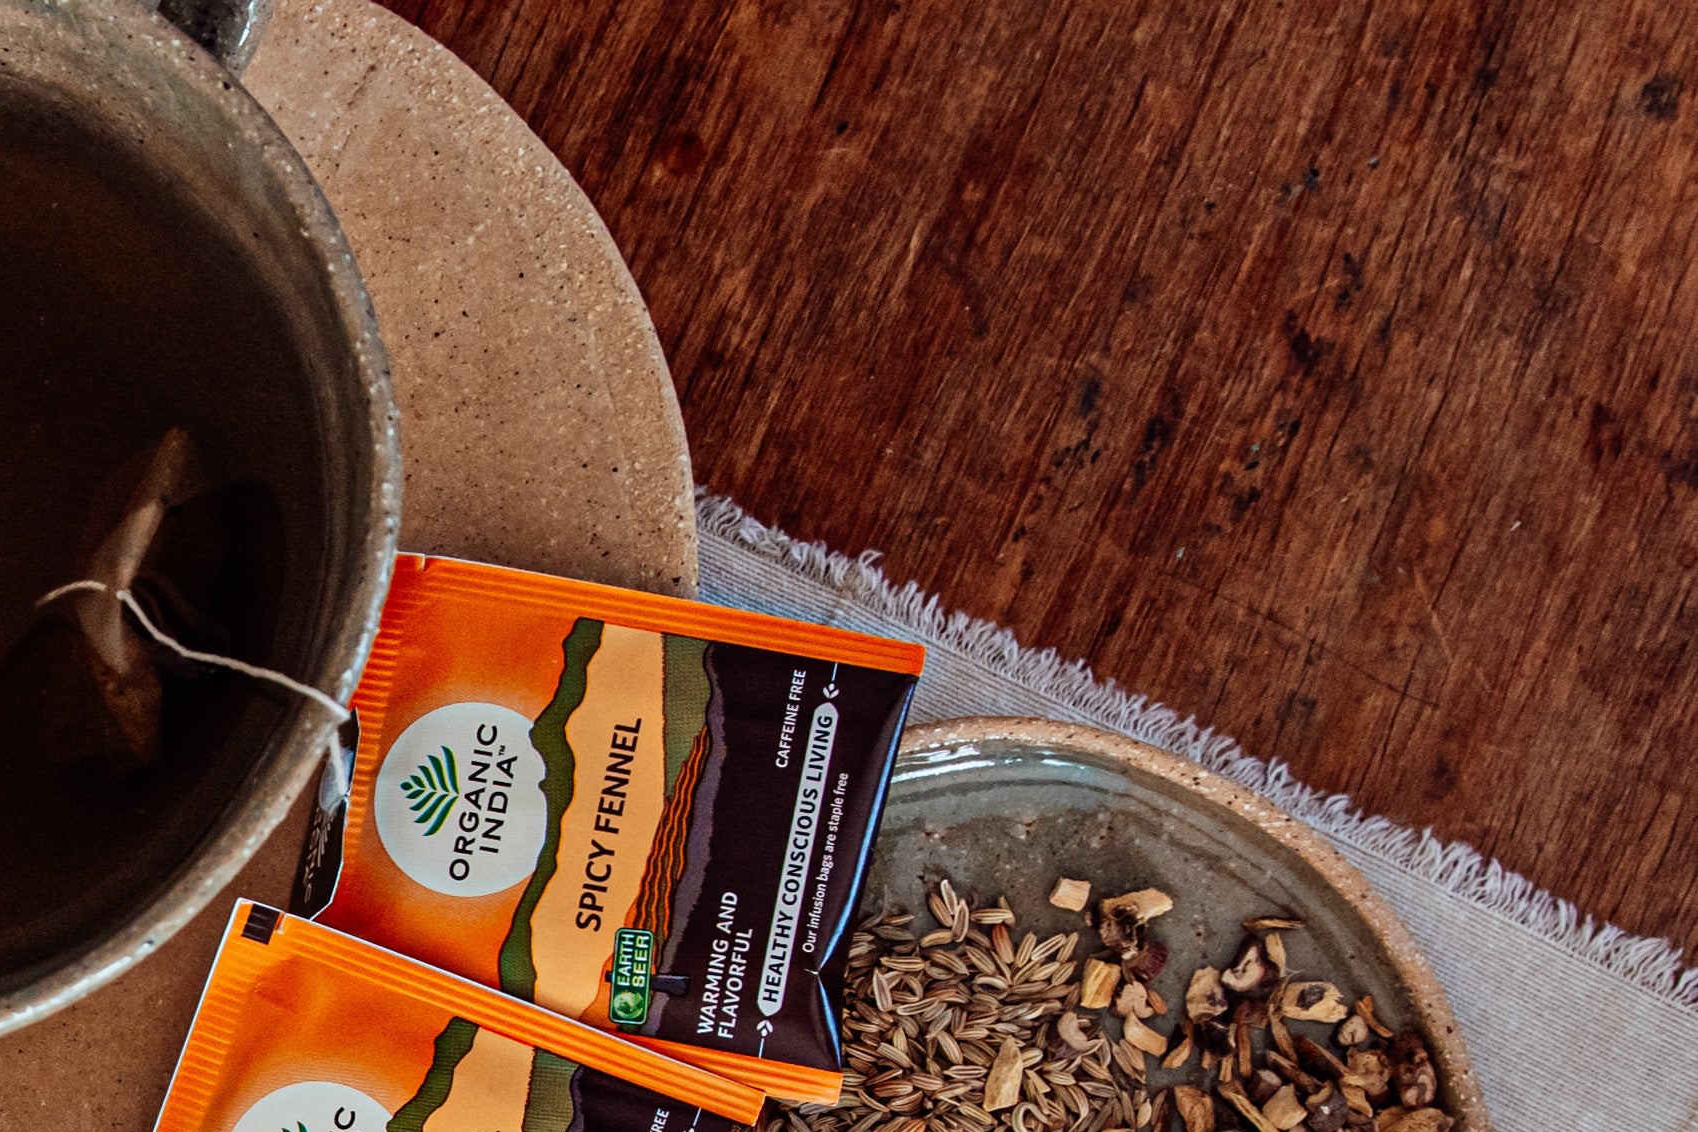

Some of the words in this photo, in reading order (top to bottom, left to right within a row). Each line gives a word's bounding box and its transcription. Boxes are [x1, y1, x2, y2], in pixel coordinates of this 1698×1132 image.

[775, 705, 801, 769] CAFFEINE
[789, 670, 806, 702] FREE
[449, 722, 498, 880] ORGANIC
[833, 772, 849, 798] free
[575, 840, 615, 932] SPICY
[596, 718, 641, 833] FENNEL
[828, 797, 844, 833] staple
[762, 910, 795, 1003] HEALTHY
[781, 787, 819, 905] CONSCIOUS
[804, 714, 834, 782] LIVING
[816, 854, 834, 882] bags
[825, 833, 837, 853] are
[808, 884, 827, 930] infusion
[617, 934, 635, 986] EARTH
[632, 934, 651, 988] SEER
[697, 936, 730, 1034] WARMING
[718, 891, 738, 931] AND
[802, 929, 817, 953] Our
[718, 927, 753, 1039] FLAVORFUL
